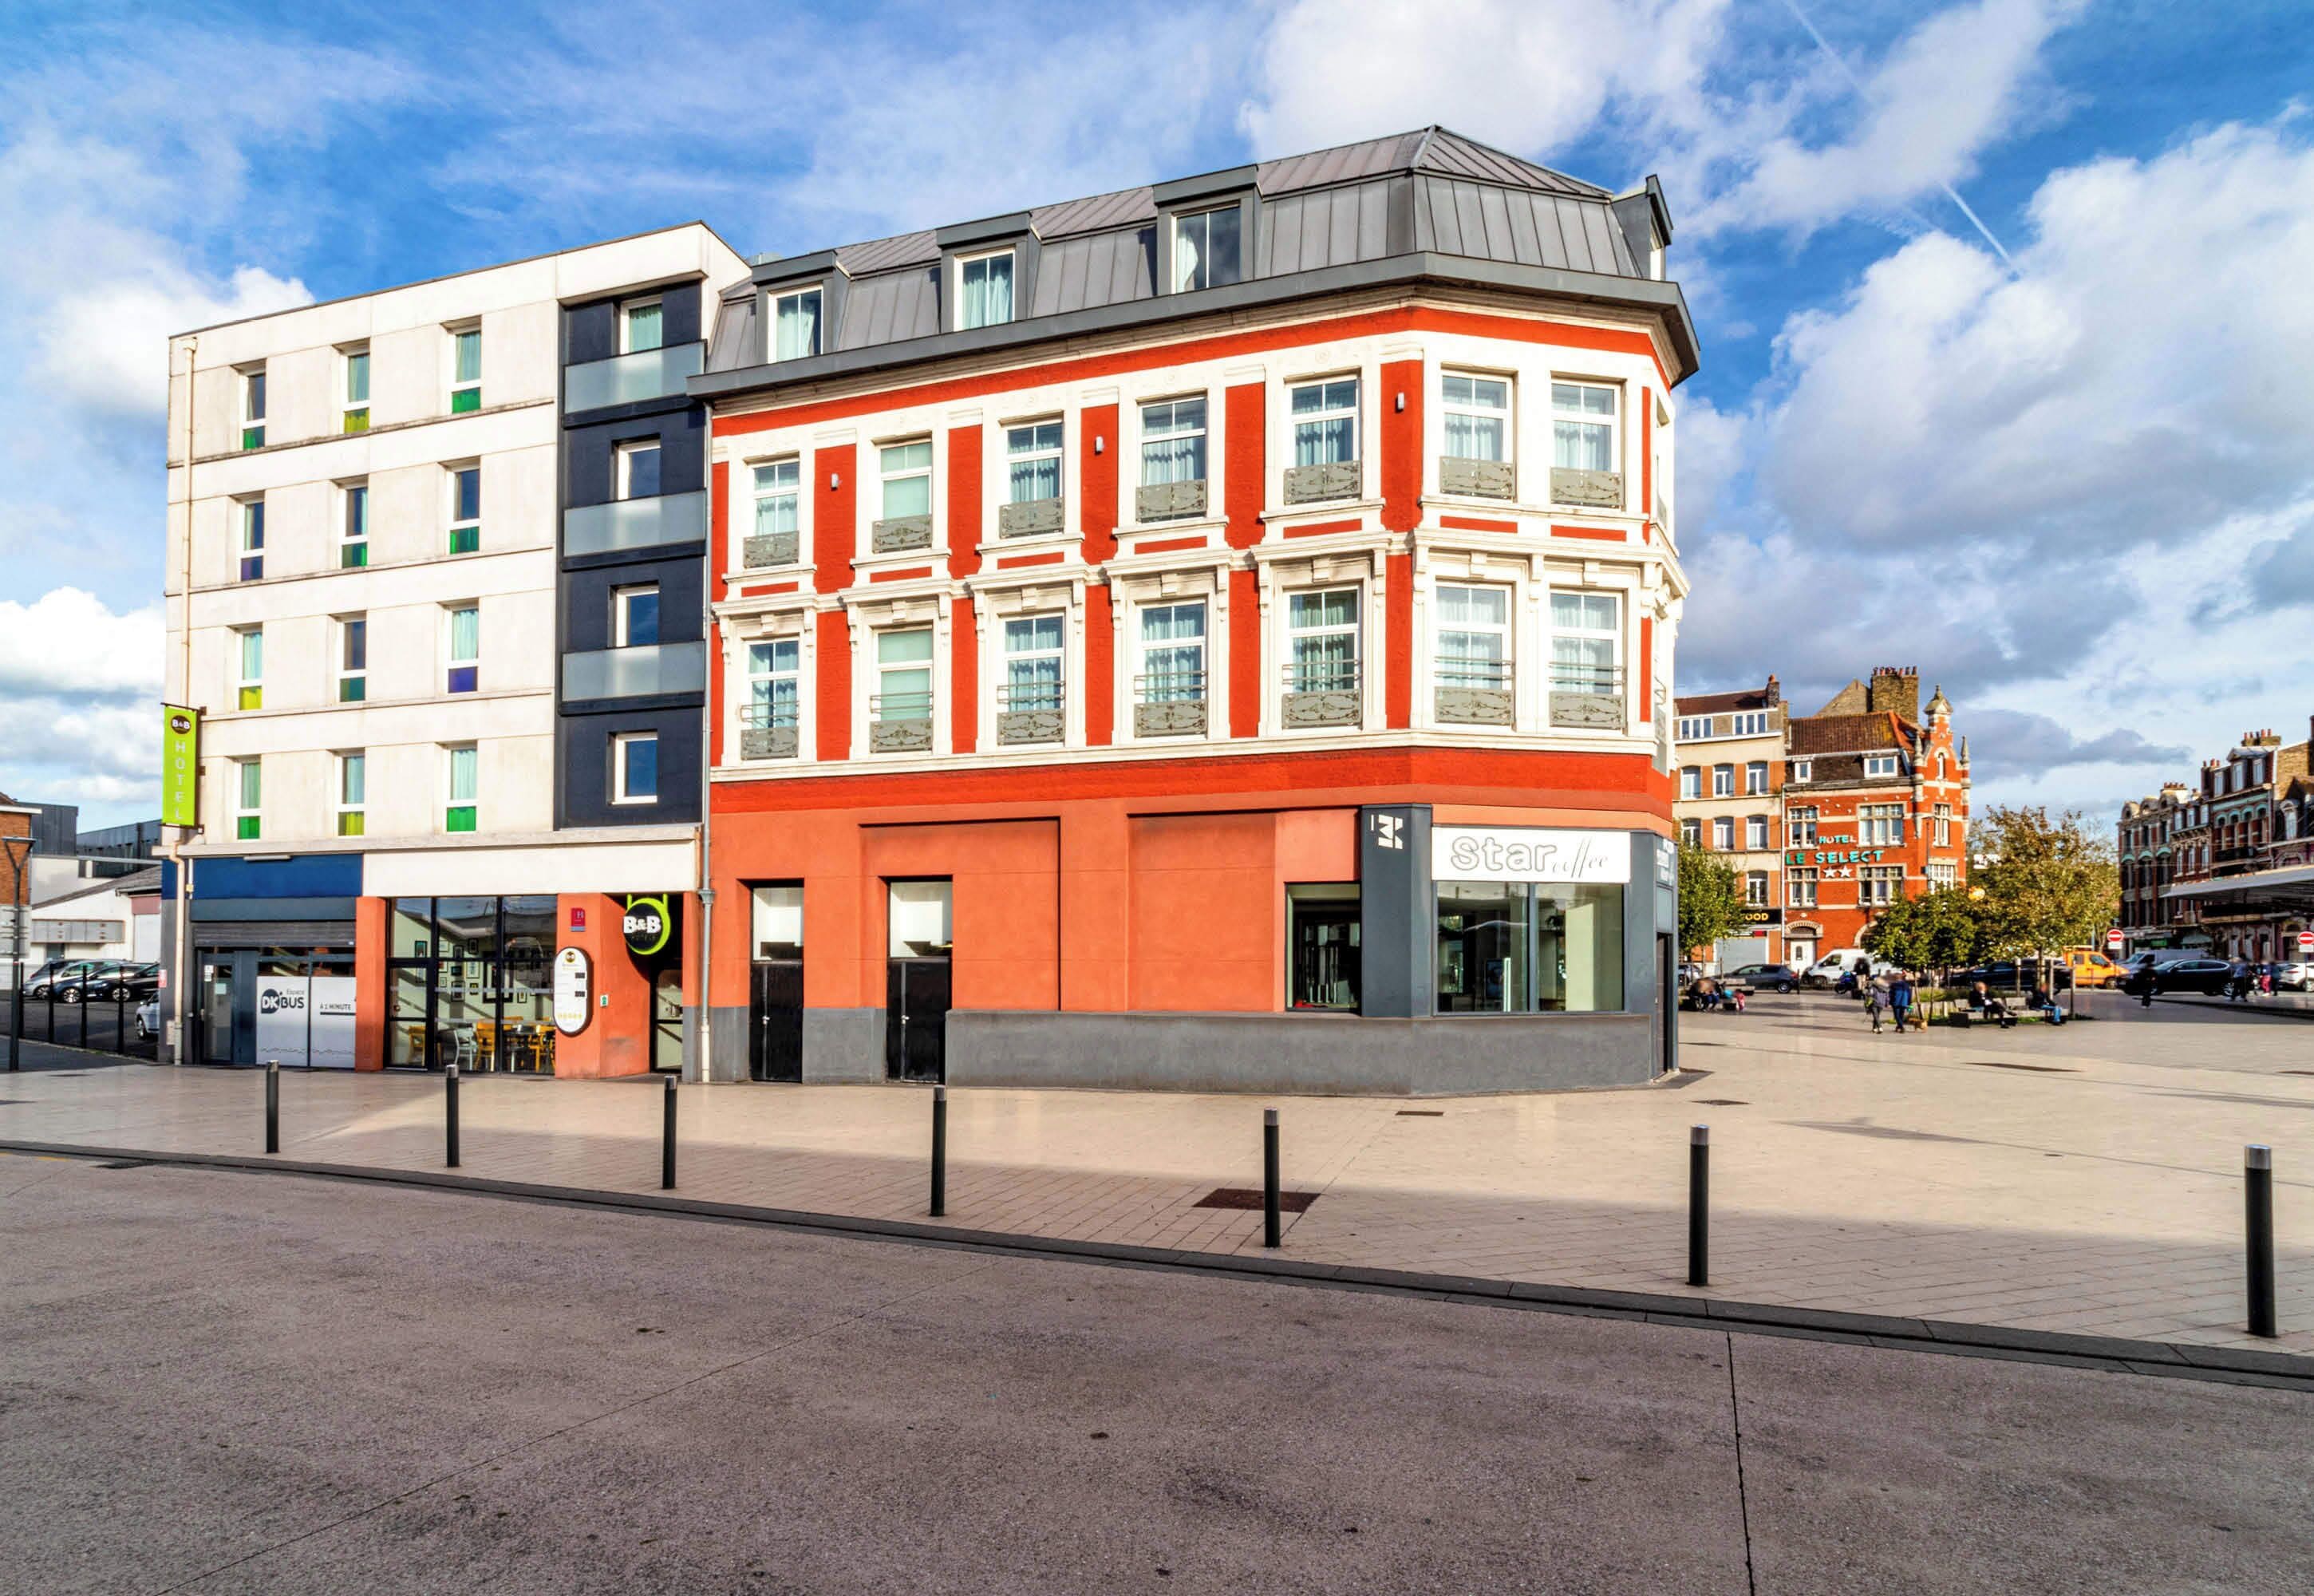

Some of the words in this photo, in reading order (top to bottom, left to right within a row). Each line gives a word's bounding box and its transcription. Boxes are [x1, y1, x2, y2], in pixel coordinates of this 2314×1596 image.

[172, 718, 191, 729] B&B
[175, 741, 186, 820] HOTEL
[1818, 834, 1857, 844] HOTEL
[1451, 836, 1558, 872] Star
[1786, 852, 1807, 865] LE
[1814, 849, 1885, 864] SELECT
[623, 915, 661, 934] B&B
[1740, 913, 1769, 922] OOD
